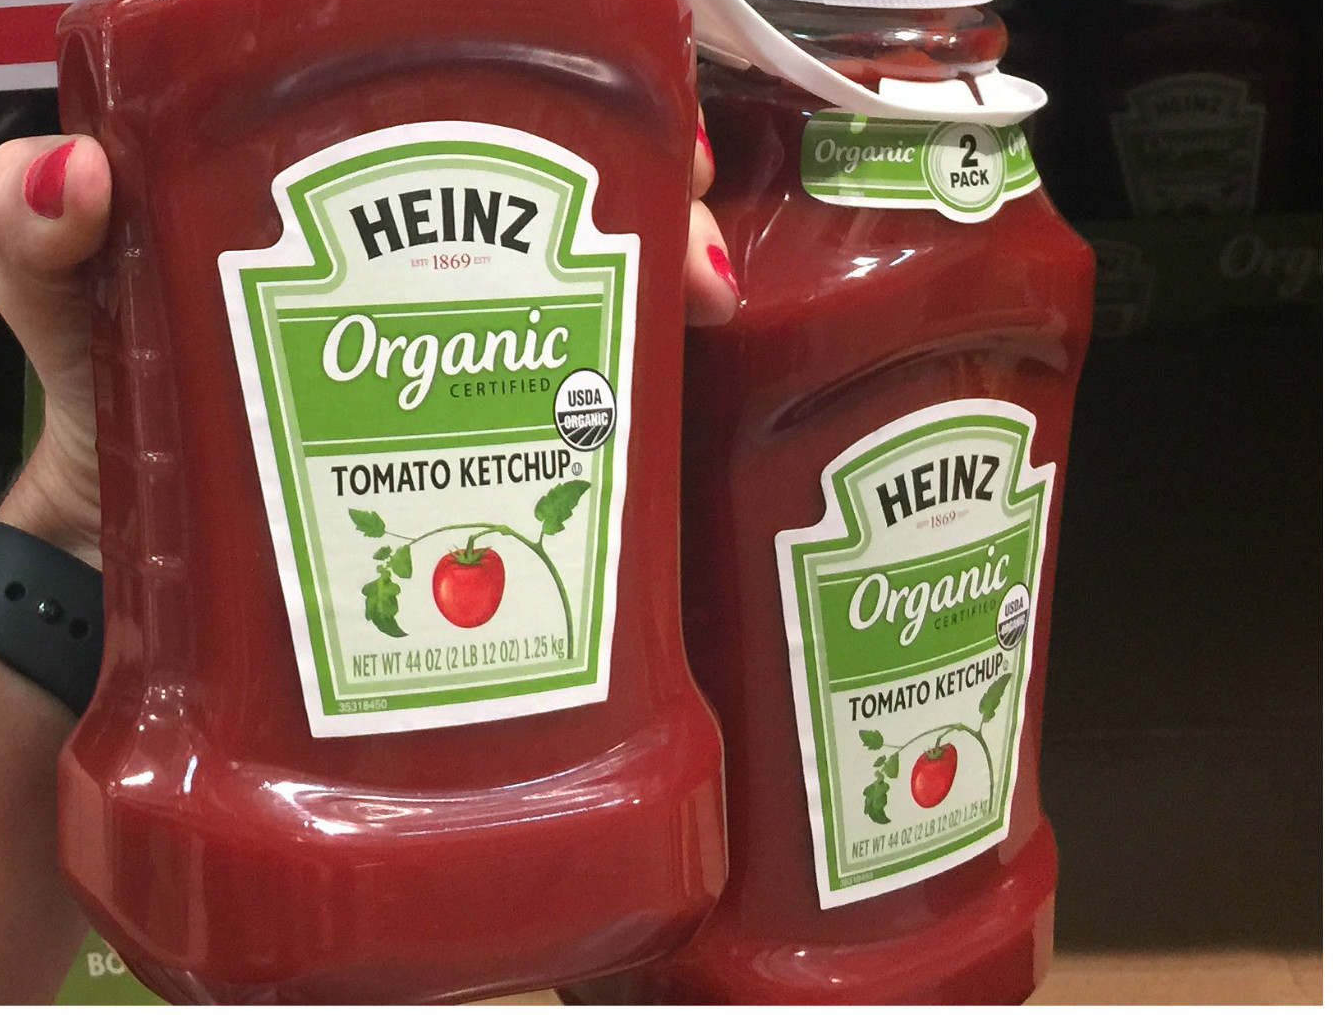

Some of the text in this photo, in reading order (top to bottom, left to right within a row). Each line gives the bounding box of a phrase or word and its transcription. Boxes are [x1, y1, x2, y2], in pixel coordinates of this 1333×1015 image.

[347, 186, 540, 261] HEINZ
[432, 252, 472, 271] 1869
[322, 309, 569, 412] Organic
[450, 376, 552, 399] CERTIFIED
[567, 388, 603, 407] USDA
[331, 448, 571, 497] TOMATO KETCHUP
[876, 453, 1001, 529] HEINZ
[848, 544, 1010, 648] Organic
[352, 633, 565, 678] NET WT 44 OZ (2 LB 12 OZ) 1.25 kg
[848, 652, 1004, 722] TOMATO KETCHUP
